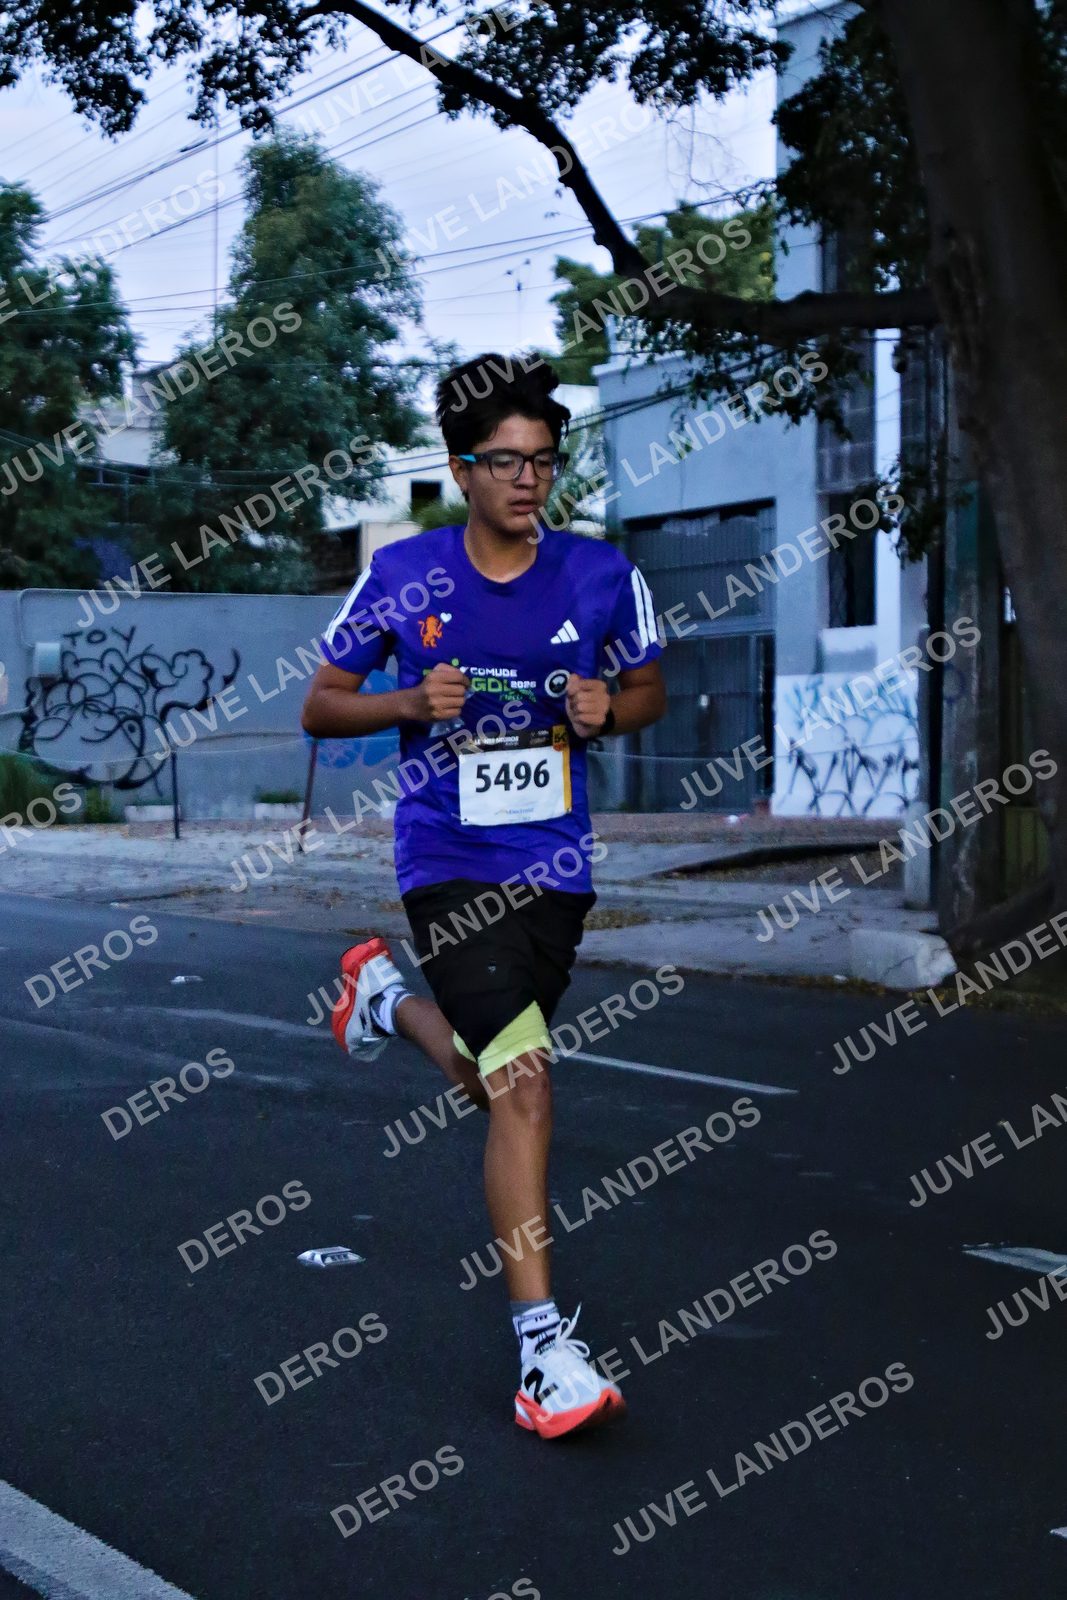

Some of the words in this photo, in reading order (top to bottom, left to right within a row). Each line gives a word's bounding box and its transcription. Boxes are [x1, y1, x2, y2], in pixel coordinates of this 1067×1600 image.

[63, 626, 136, 652] TOY
[470, 667, 518, 677] COMUDE
[475, 760, 550, 793] 5496
